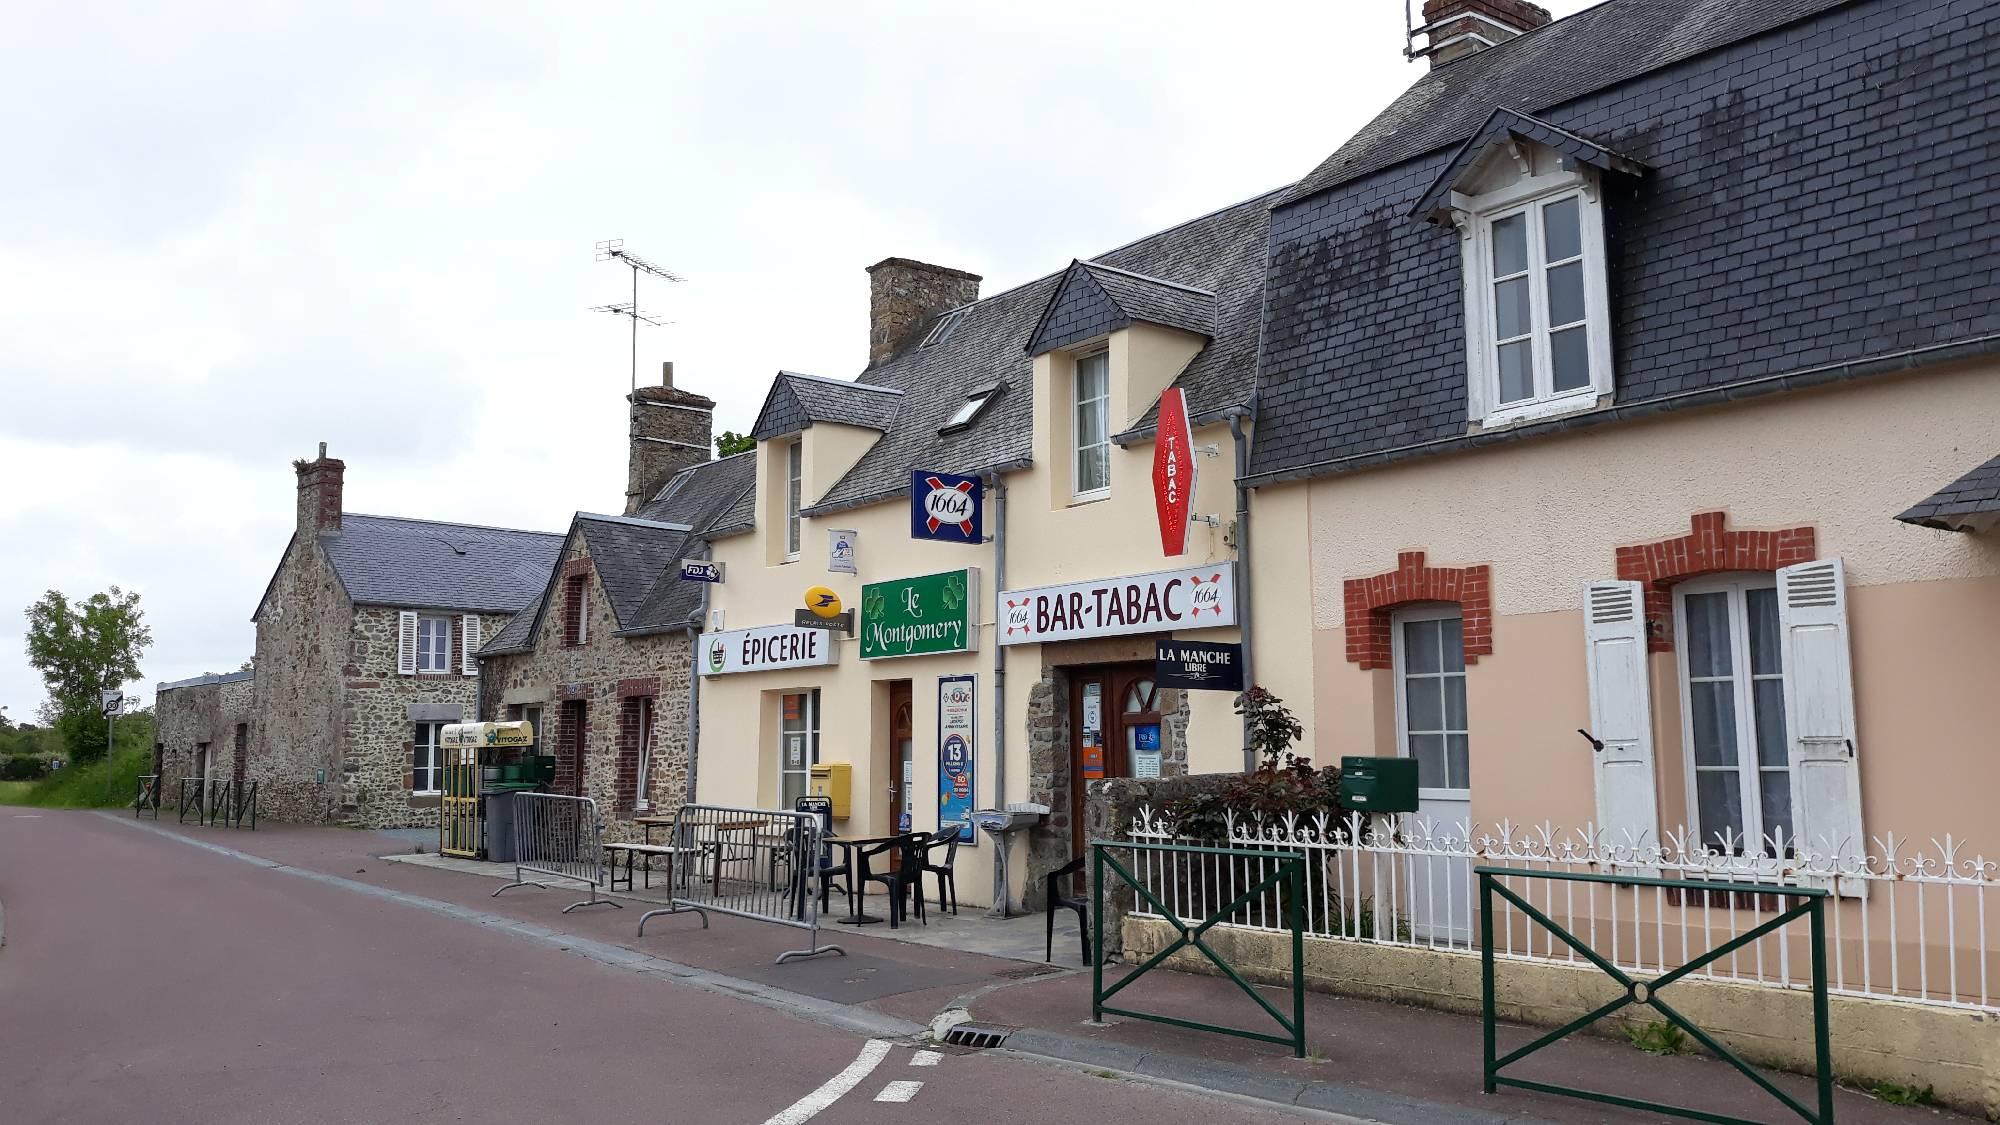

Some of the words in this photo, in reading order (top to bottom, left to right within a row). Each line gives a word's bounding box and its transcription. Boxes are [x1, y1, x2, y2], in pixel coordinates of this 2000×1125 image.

[1167, 436, 1177, 504] TABAC
[930, 492, 969, 517] 1664
[687, 565, 704, 575] FDJ
[901, 586, 923, 618] Le
[1193, 586, 1219, 604] 1664
[1036, 578, 1183, 634] BAR-TABAC
[1009, 609, 1028, 624] 1664
[865, 619, 962, 653] Montgomery
[741, 631, 818, 666] ÉPICERIE
[1159, 648, 1175, 662] LA
[1180, 649, 1232, 665] MANCHE
[1184, 662, 1207, 673] LIBRE
[496, 735, 528, 744] VITOGAZ
[947, 743, 962, 761] 13
[957, 775, 966, 783] 50
